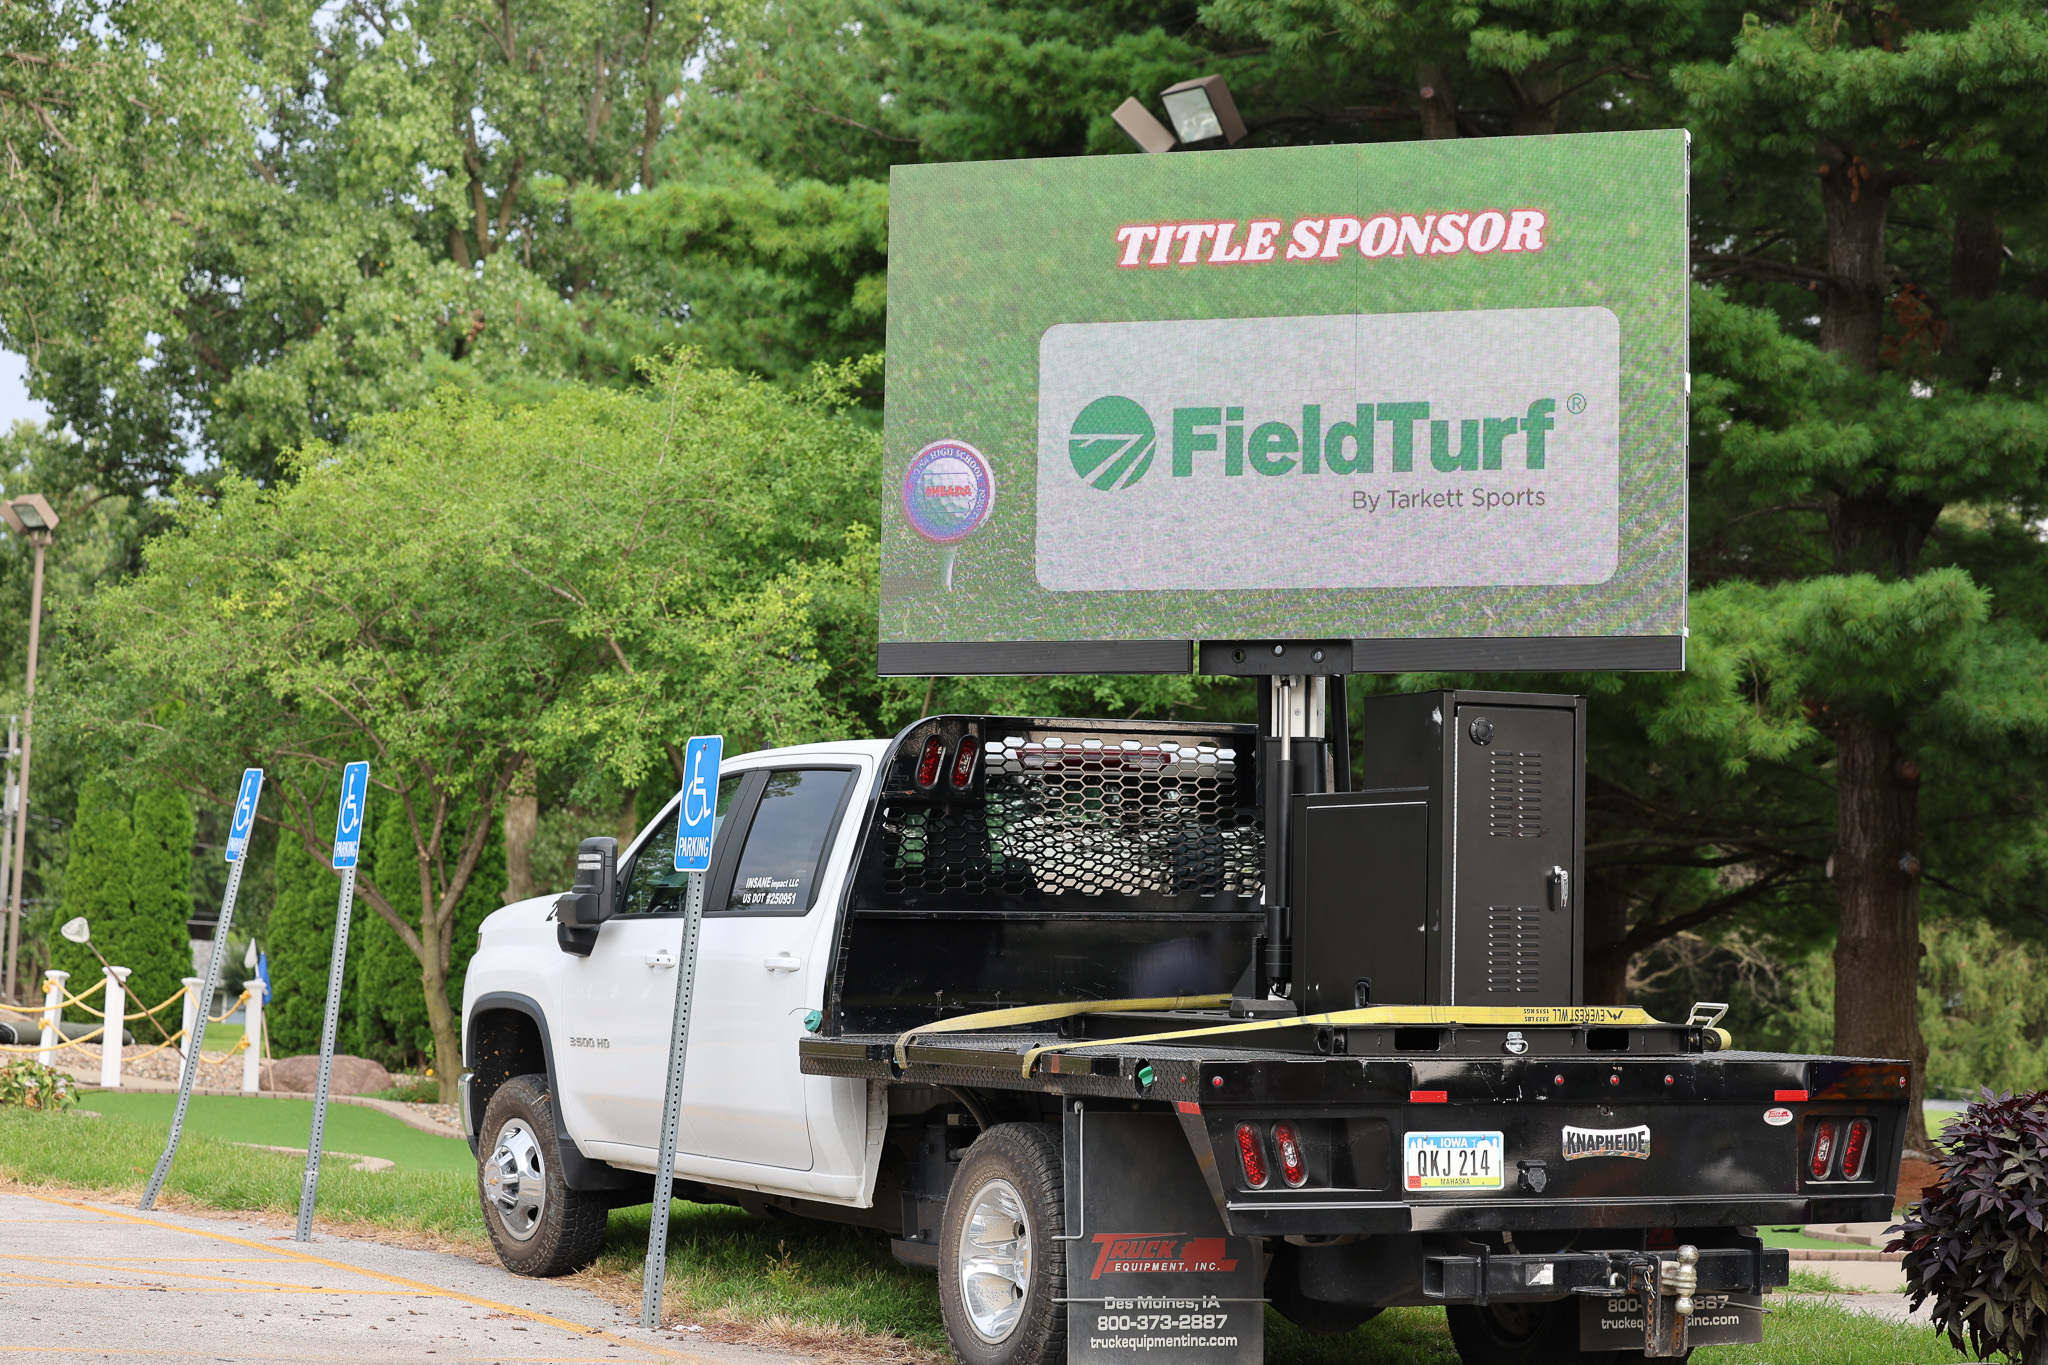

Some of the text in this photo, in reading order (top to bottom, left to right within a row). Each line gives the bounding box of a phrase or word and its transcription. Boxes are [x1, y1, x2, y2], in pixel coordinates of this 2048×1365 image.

[1116, 210, 1546, 266] TITLE SPONSOR
[1172, 398, 1556, 477] FieldTurf
[1352, 487, 1545, 512] By Tarkett Sports
[335, 840, 358, 858] PARKING
[678, 836, 710, 858] PARKING
[745, 876, 800, 890] INSANE impact LLC
[742, 892, 797, 905] US DOT #250951
[1552, 1008, 1605, 1023] EVEREST WLL
[569, 1037, 610, 1049] 3500 HD
[1440, 1137, 1469, 1148] IOWA
[1566, 1131, 1646, 1154] KNAPHEIDE
[1417, 1149, 1490, 1177] QKJ 214
[1440, 1178, 1471, 1186] MAHASKA
[1090, 1232, 1187, 1280] TRUCK
[1114, 1262, 1221, 1272] EQUIPMENT, INC.
[1104, 1295, 1221, 1311] Des Moines, IA
[1097, 1314, 1228, 1331] 800-373-2887
[1090, 1333, 1238, 1351] truckequipmentinc.com
